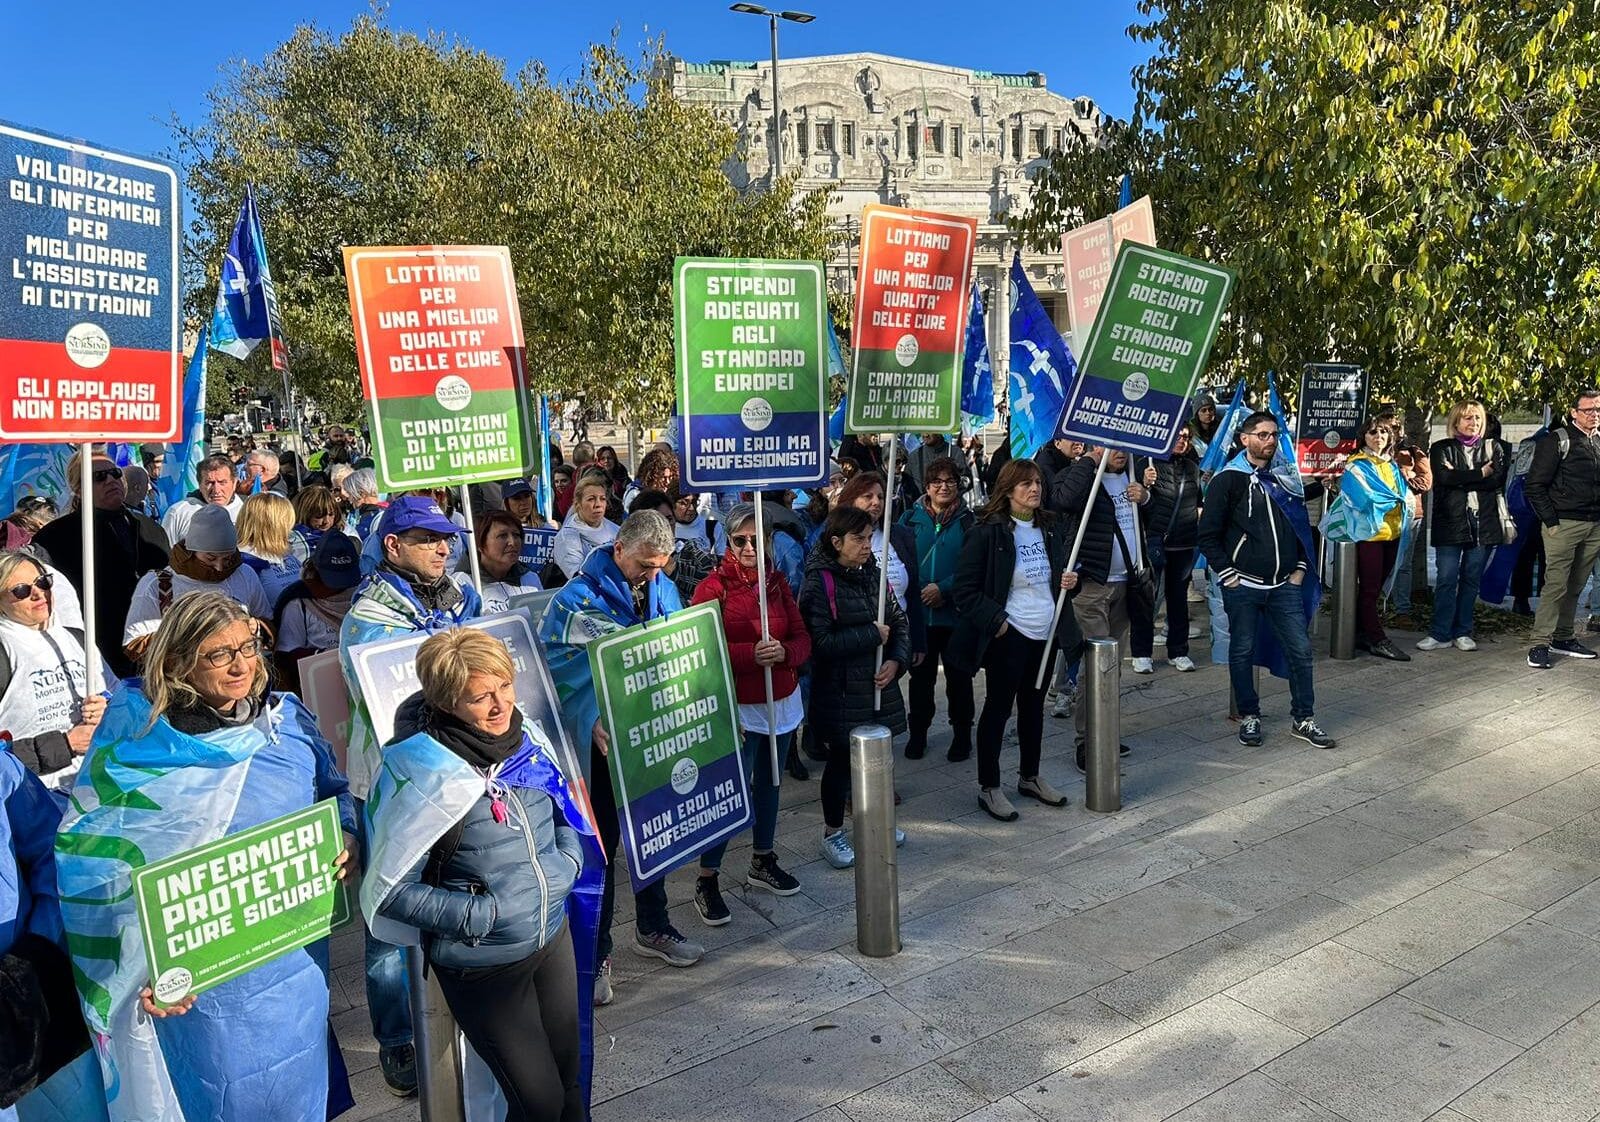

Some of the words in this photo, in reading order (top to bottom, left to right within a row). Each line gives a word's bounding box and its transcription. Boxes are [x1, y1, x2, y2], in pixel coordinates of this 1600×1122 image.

[16, 155, 156, 202] VALORIZZARE
[10, 180, 43, 205] GLI
[51, 189, 161, 227] INFERMIERI
[68, 217, 108, 241] PER
[886, 227, 951, 251] LOTTIAMO
[26, 235, 148, 271] MIGLIORARE
[904, 251, 929, 268] PER
[13, 258, 160, 296] L'ASSISTENZA
[385, 265, 481, 284] LOTTIAMO
[706, 276, 796, 296] STIPENDI
[873, 268, 900, 286] UNA
[904, 272, 954, 291] MIGLIOR
[1137, 262, 1209, 295] STIPENDI
[22, 286, 43, 306] AI
[50, 289, 151, 317] CITTADINI
[419, 287, 457, 305] PER
[883, 291, 940, 310] QUALITA'
[1128, 283, 1205, 316] ADEGUATI
[378, 310, 420, 329] UNA
[426, 308, 500, 327] MIGLIOR
[704, 301, 800, 320] ADEGUATI
[872, 311, 911, 328] DELLE
[914, 314, 947, 331] CURE
[1140, 308, 1178, 331] AGLI
[400, 330, 487, 351] QUALITA'
[732, 325, 776, 344] AGLI
[1110, 323, 1193, 357] STANDARD
[389, 353, 449, 373] DELLE
[455, 350, 502, 369] CURE
[701, 350, 806, 369] STANDARD
[1112, 346, 1177, 374] EUROPEI
[17, 377, 50, 398] GLI
[57, 379, 156, 401] APPLAUSI
[714, 373, 794, 392] EUROPEI
[868, 372, 940, 388] CONDIZIONI
[868, 389, 880, 403] DI
[885, 389, 937, 403] LAVORO
[1329, 391, 1344, 399] PER
[12, 399, 54, 419] NON
[61, 401, 161, 421] BASTANO!
[862, 405, 888, 419] PIU'
[892, 405, 941, 419] UMANE!
[1081, 396, 1110, 415] NON
[1113, 403, 1145, 419] EROI
[1148, 411, 1169, 426] MA
[1306, 409, 1360, 418] L'ASSISTENZA
[400, 413, 508, 438] CONDIZIONI
[1072, 410, 1169, 441] PROFESSIONISTI!
[1308, 419, 1318, 427] AI
[1319, 418, 1356, 427] CITTADINI
[407, 438, 427, 456] DI
[434, 430, 508, 453] LAVORO
[700, 437, 736, 454] NON
[743, 436, 780, 452] EROI
[788, 435, 811, 450] MA
[402, 455, 441, 474] PIU'
[450, 447, 516, 469] UMANE!
[695, 451, 817, 471] PROFESSIONISTI!
[1301, 460, 1318, 469] NON
[524, 533, 543, 546] ON
[621, 626, 700, 669] STIPENDI
[623, 648, 707, 696] ADEGUATI
[35, 685, 65, 700] Monza
[651, 680, 690, 711] AGLI
[38, 701, 65, 715] SENZA
[39, 711, 59, 722] NON
[628, 695, 718, 748] STANDARD
[643, 721, 713, 768] EUROPEI
[641, 810, 673, 840] NON
[677, 791, 709, 820] EROI
[714, 779, 735, 801] MA
[640, 792, 743, 861] PROFESSIONISTI!
[156, 820, 324, 905] INFERMIERI
[161, 849, 329, 935] PROTETTI.
[166, 914, 236, 959] CURE
[243, 872, 333, 928] SICURE!
